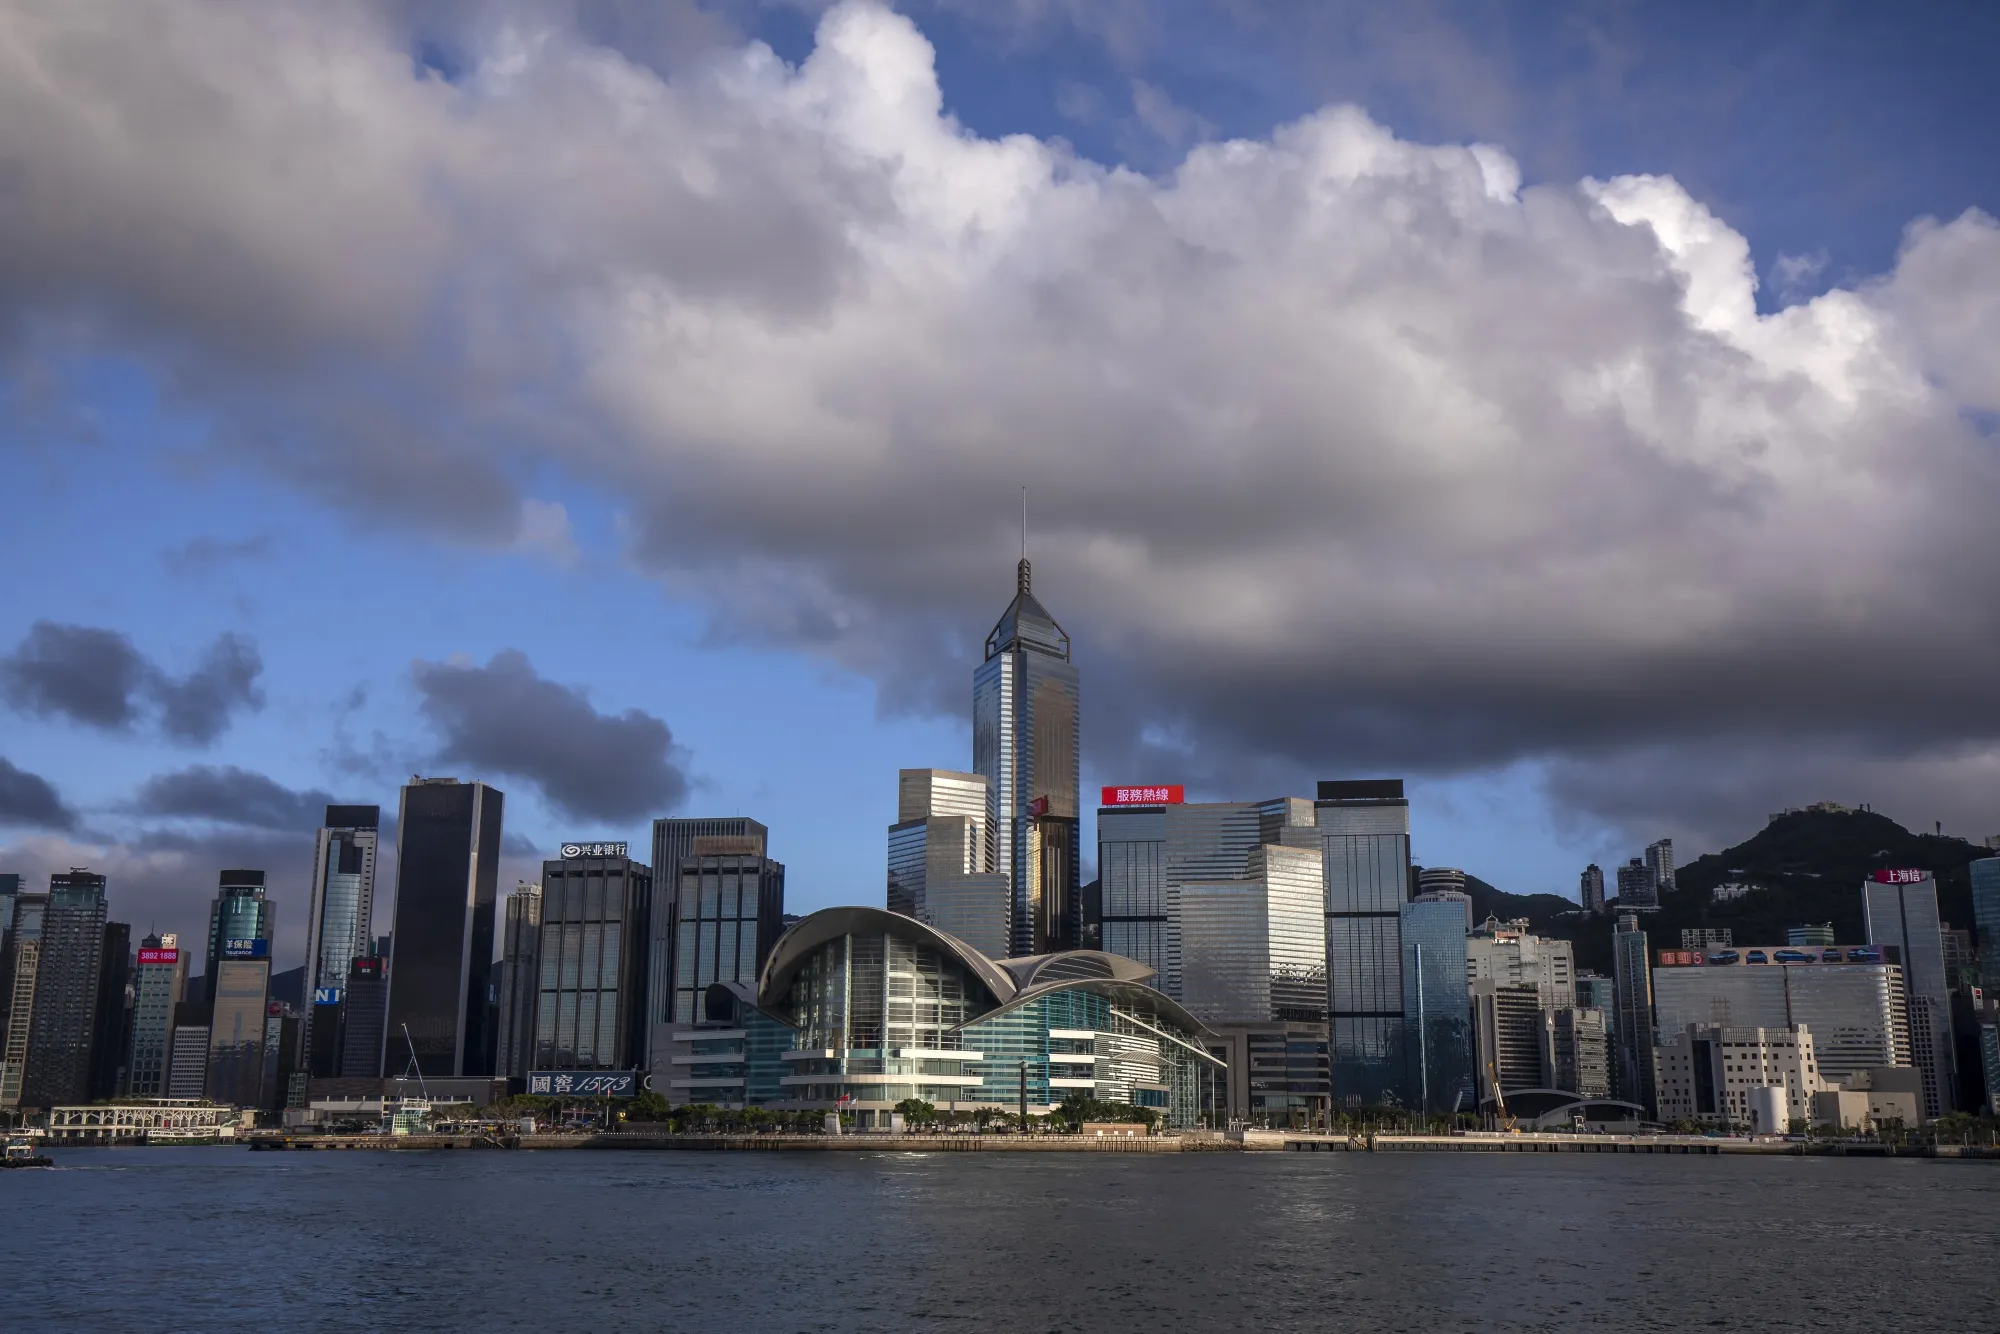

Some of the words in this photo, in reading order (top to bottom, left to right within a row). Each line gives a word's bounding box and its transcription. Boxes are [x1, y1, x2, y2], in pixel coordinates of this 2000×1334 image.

[1116, 788, 1168, 802] 服務熱線
[581, 844, 626, 856] 兴业银行
[1887, 870, 1920, 883] 上海信
